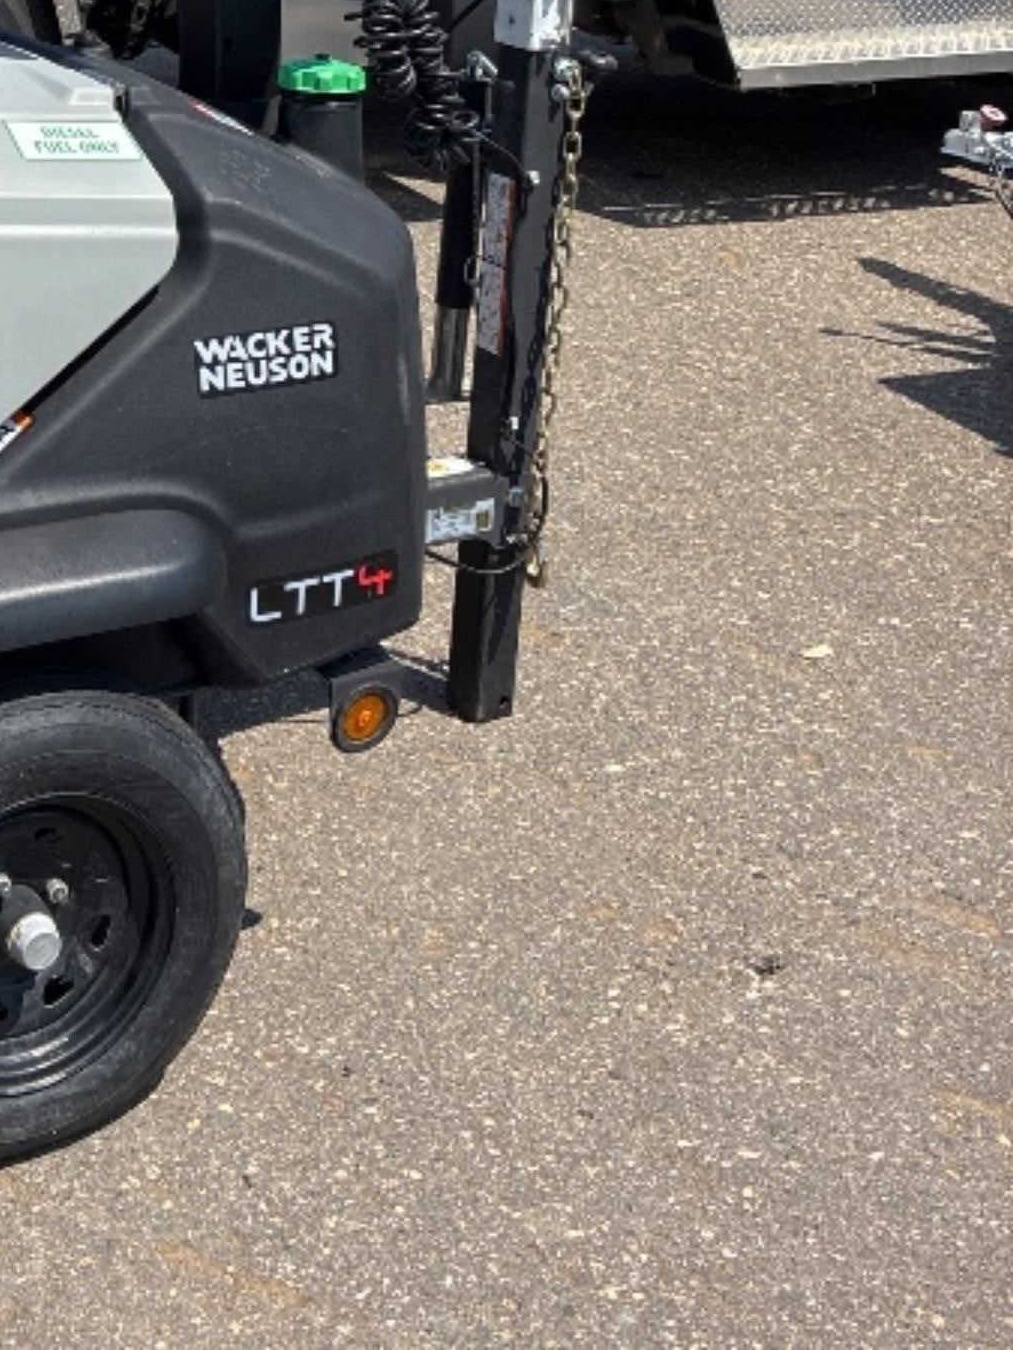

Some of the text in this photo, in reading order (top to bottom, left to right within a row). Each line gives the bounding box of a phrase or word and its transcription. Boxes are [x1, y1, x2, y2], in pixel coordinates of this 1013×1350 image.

[193, 323, 335, 365] WACKER
[198, 350, 334, 392] NEUSON
[249, 564, 393, 622] LTT4
